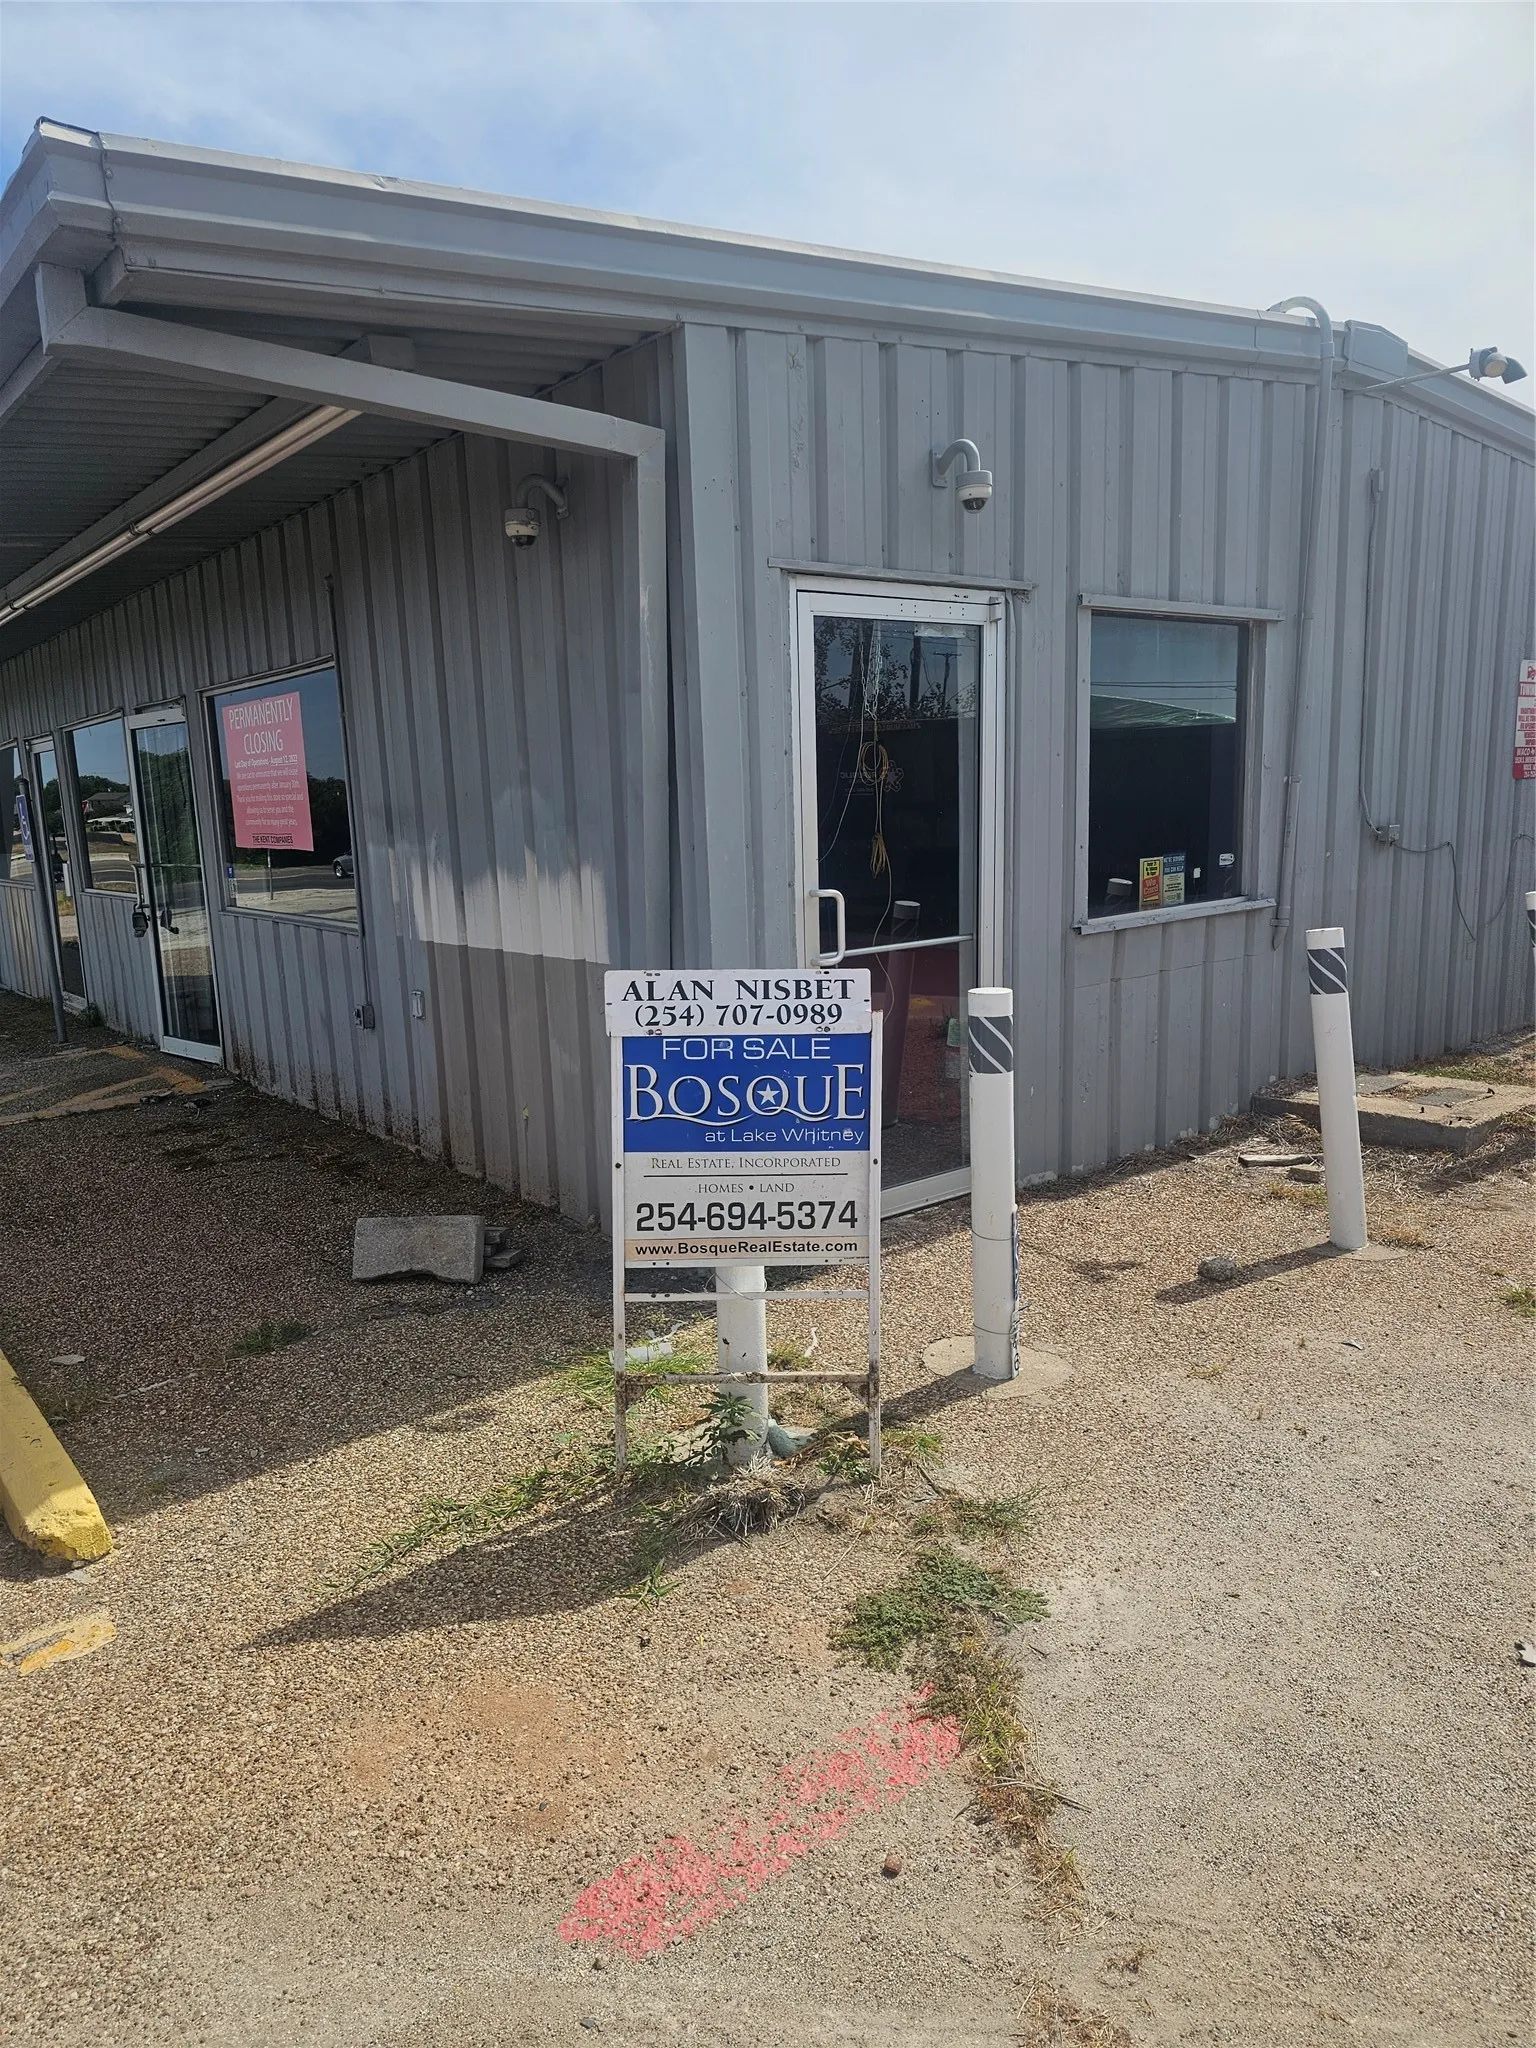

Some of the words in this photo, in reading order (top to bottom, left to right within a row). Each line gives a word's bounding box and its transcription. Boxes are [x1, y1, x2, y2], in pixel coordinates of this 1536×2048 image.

[229, 697, 294, 730] PERMANENTLY
[243, 729, 284, 755] CLOSING
[271, 836, 293, 844] COMPANIES
[621, 979, 715, 1002] ALAN
[736, 978, 855, 1001] NISBET
[634, 1004, 705, 1028] (254)
[716, 1003, 843, 1027] 707-0989
[662, 1038, 734, 1060] FOR
[743, 1037, 832, 1060] SALE
[624, 1063, 866, 1123] BOSQUE
[704, 1130, 726, 1143] at
[731, 1128, 777, 1143] Lake
[781, 1127, 865, 1145] Whitney
[651, 1157, 684, 1170] REAL
[738, 1156, 841, 1170] INCORPORATED
[698, 1183, 744, 1194] HOMES
[759, 1182, 795, 1194] LAND
[636, 1200, 858, 1232] 254-694-5374
[635, 1240, 858, 1258] www.BosqueRealEstate.com
